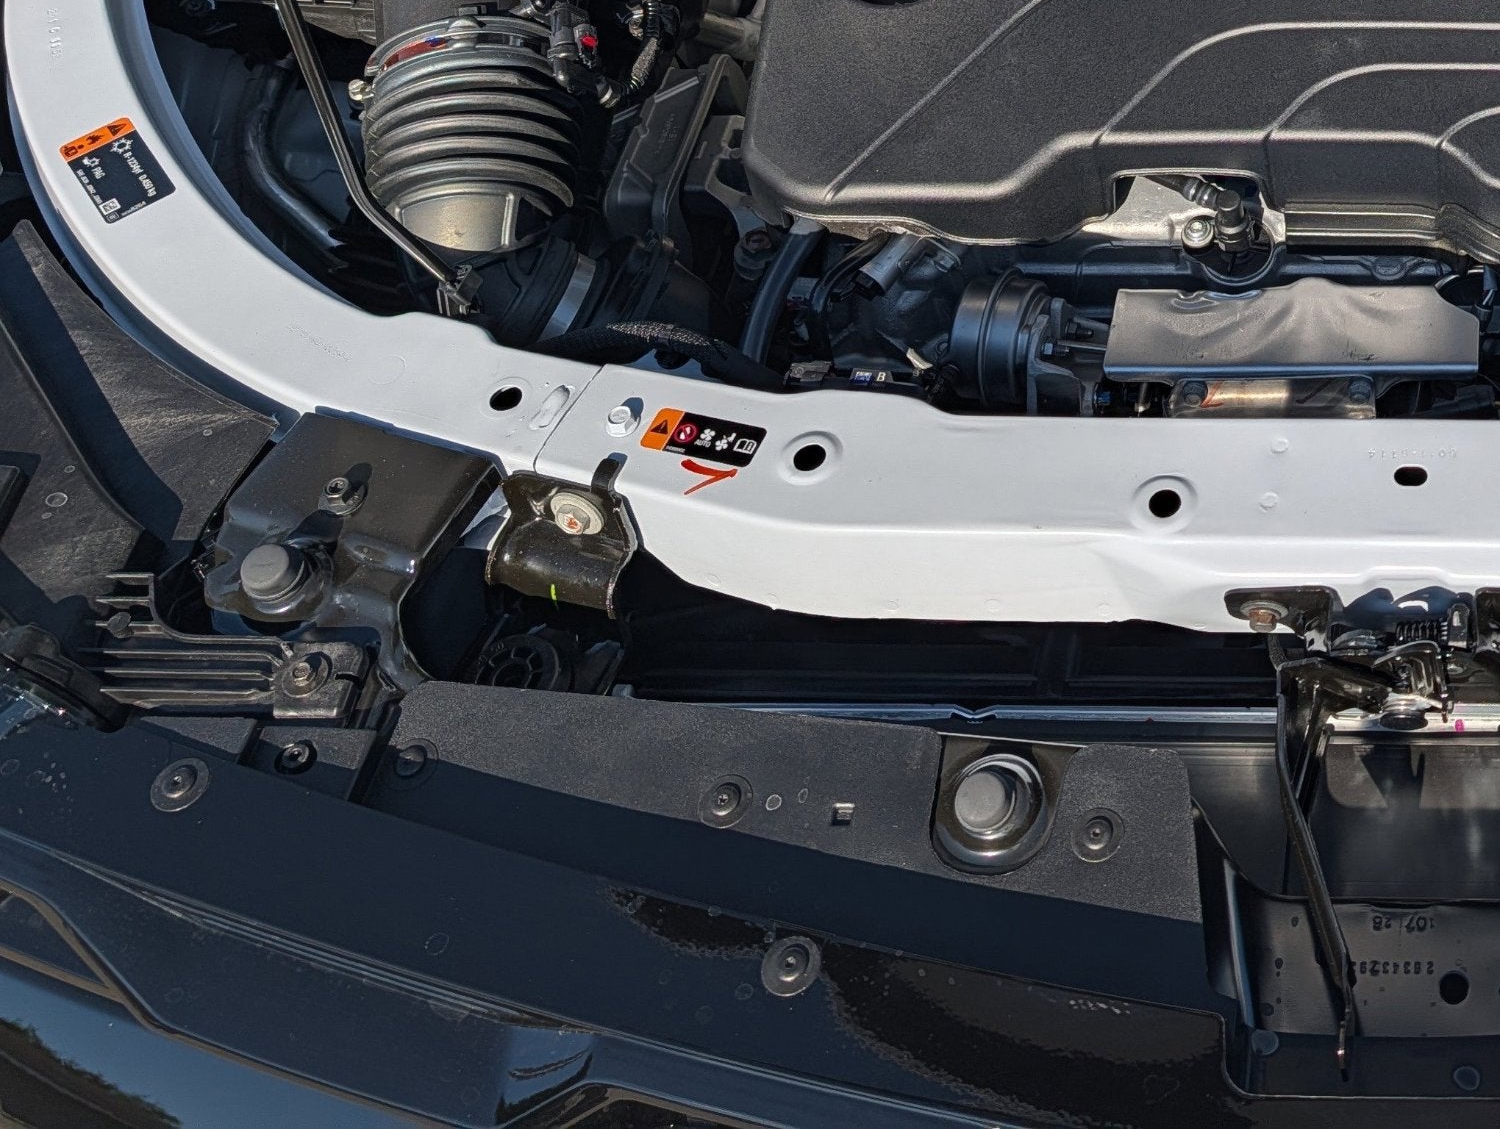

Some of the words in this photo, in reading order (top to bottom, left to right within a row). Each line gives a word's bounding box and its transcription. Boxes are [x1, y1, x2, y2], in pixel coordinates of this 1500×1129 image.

[91, 165, 105, 180] PAG
[122, 151, 143, 175] R-1234yf
[146, 186, 157, 198] kg
[694, 440, 711, 448] AUTO
